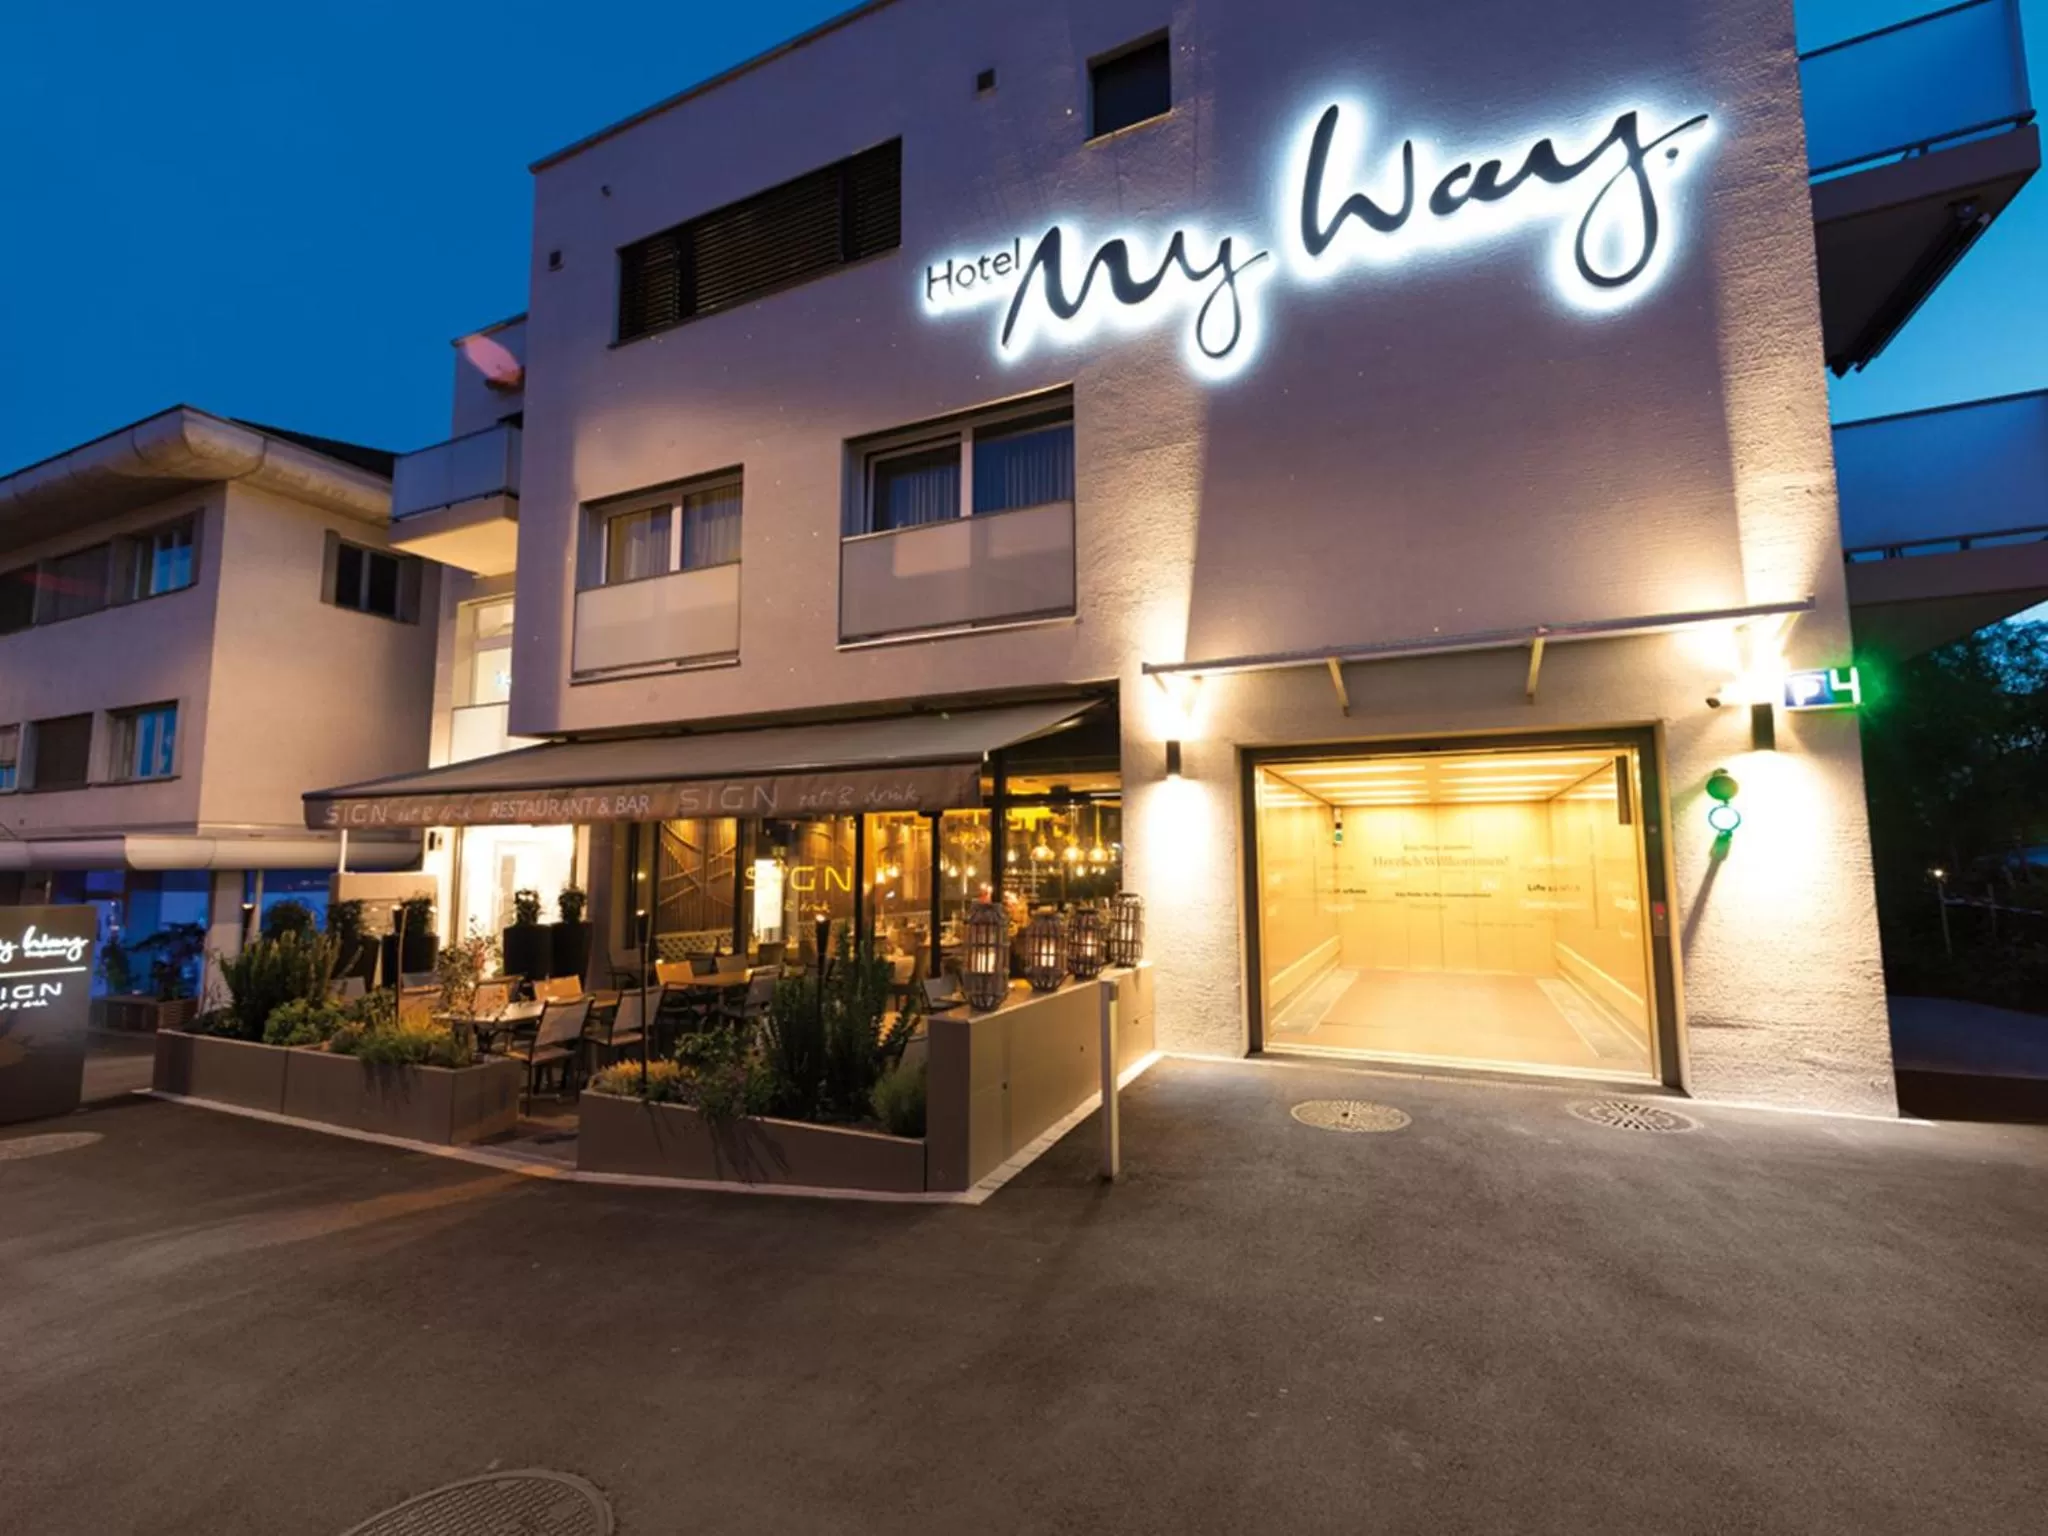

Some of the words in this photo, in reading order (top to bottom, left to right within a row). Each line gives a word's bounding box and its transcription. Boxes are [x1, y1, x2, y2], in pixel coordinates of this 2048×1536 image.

[926, 237, 1021, 302] Hotel
[1001, 223, 1269, 359] My
[323, 802, 389, 825] SIGN
[489, 797, 597, 818] RESTAURANT
[599, 797, 611, 813] &
[615, 795, 650, 814] BAR
[678, 785, 779, 812] SIGN
[837, 785, 855, 806] &
[861, 780, 921, 804] drink
[0, 982, 62, 1001] IGN
